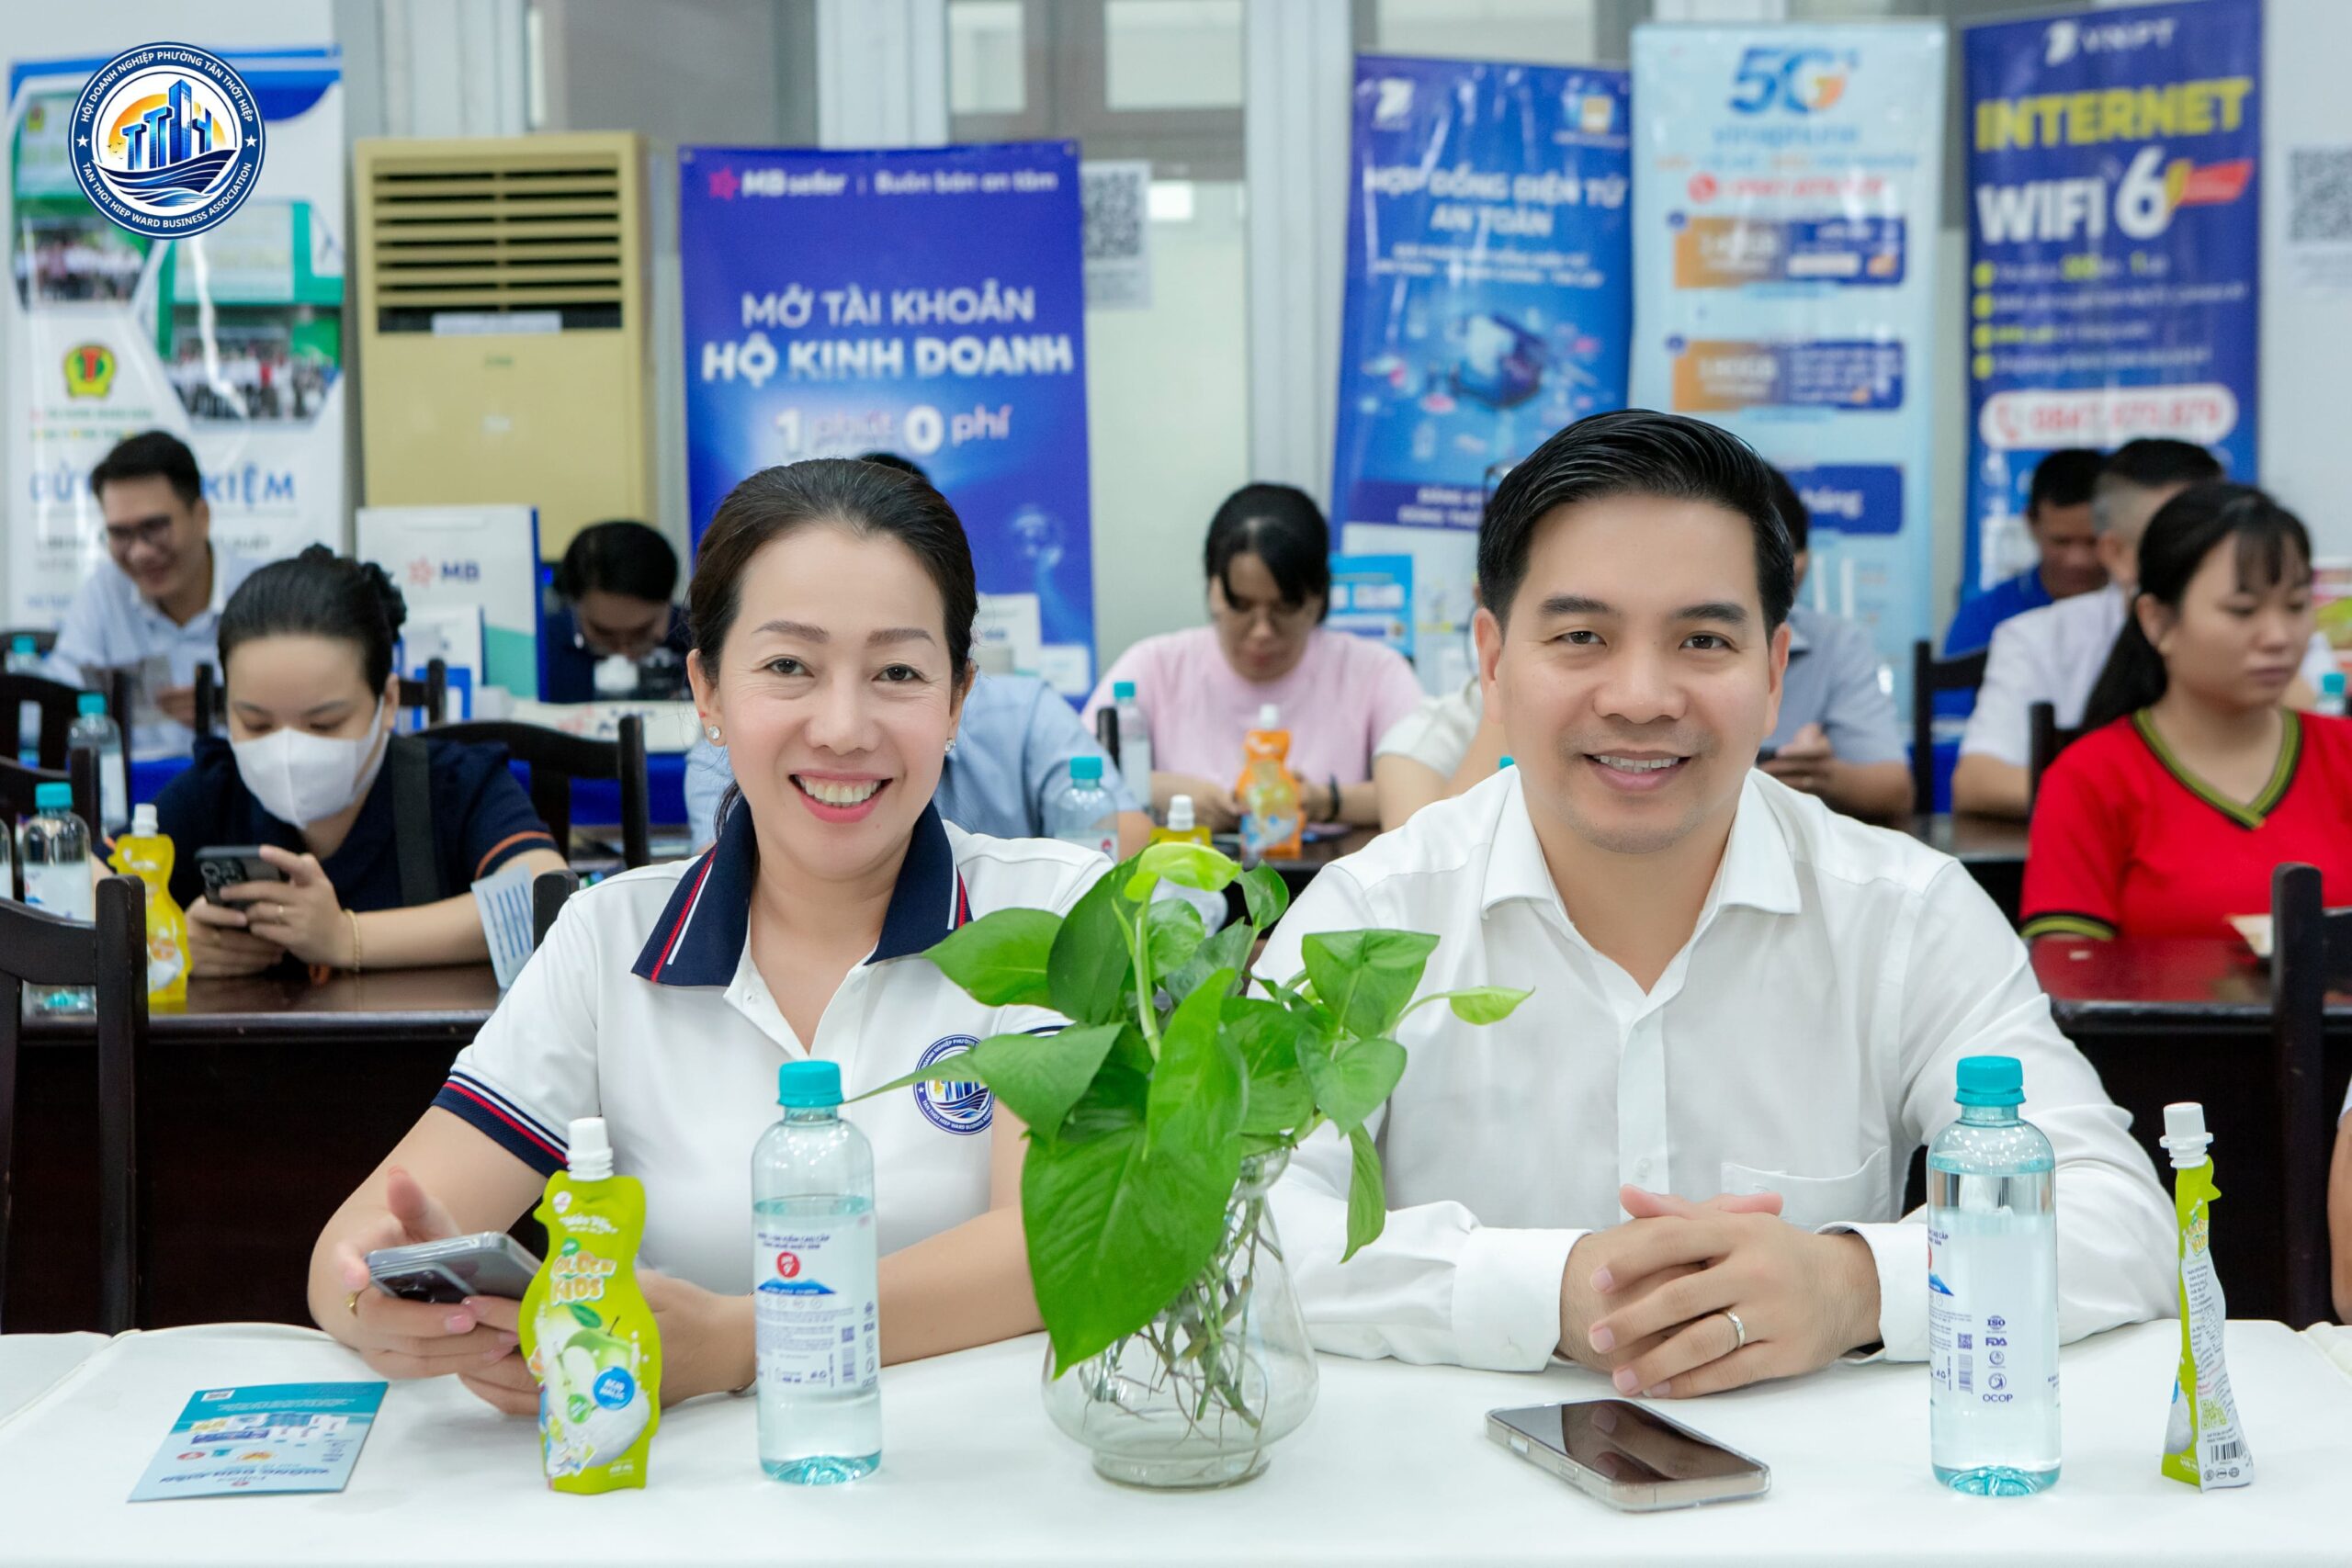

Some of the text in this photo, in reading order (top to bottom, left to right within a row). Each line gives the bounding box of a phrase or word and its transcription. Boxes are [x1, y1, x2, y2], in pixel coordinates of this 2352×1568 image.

[1974, 76, 2253, 152] INTERNET
[873, 168, 931, 196] Buôn
[933, 167, 978, 195] bán
[980, 171, 1010, 194] an
[1012, 167, 1058, 194] tâm
[1976, 145, 2171, 245] WIFI 6
[1430, 203, 1473, 231] AN
[741, 278, 1036, 329] MỞ TÀI KHOẢN
[701, 331, 1073, 388] HỘ KINH DOANH
[775, 403, 1012, 456] 1 phút 0 phí
[441, 560, 481, 582] MB
[922, 1051, 935, 1068] OANH
[1987, 1318, 2006, 1327] ISO
[1985, 1337, 2007, 1348] FDA
[1983, 1393, 2013, 1404] OCOP
